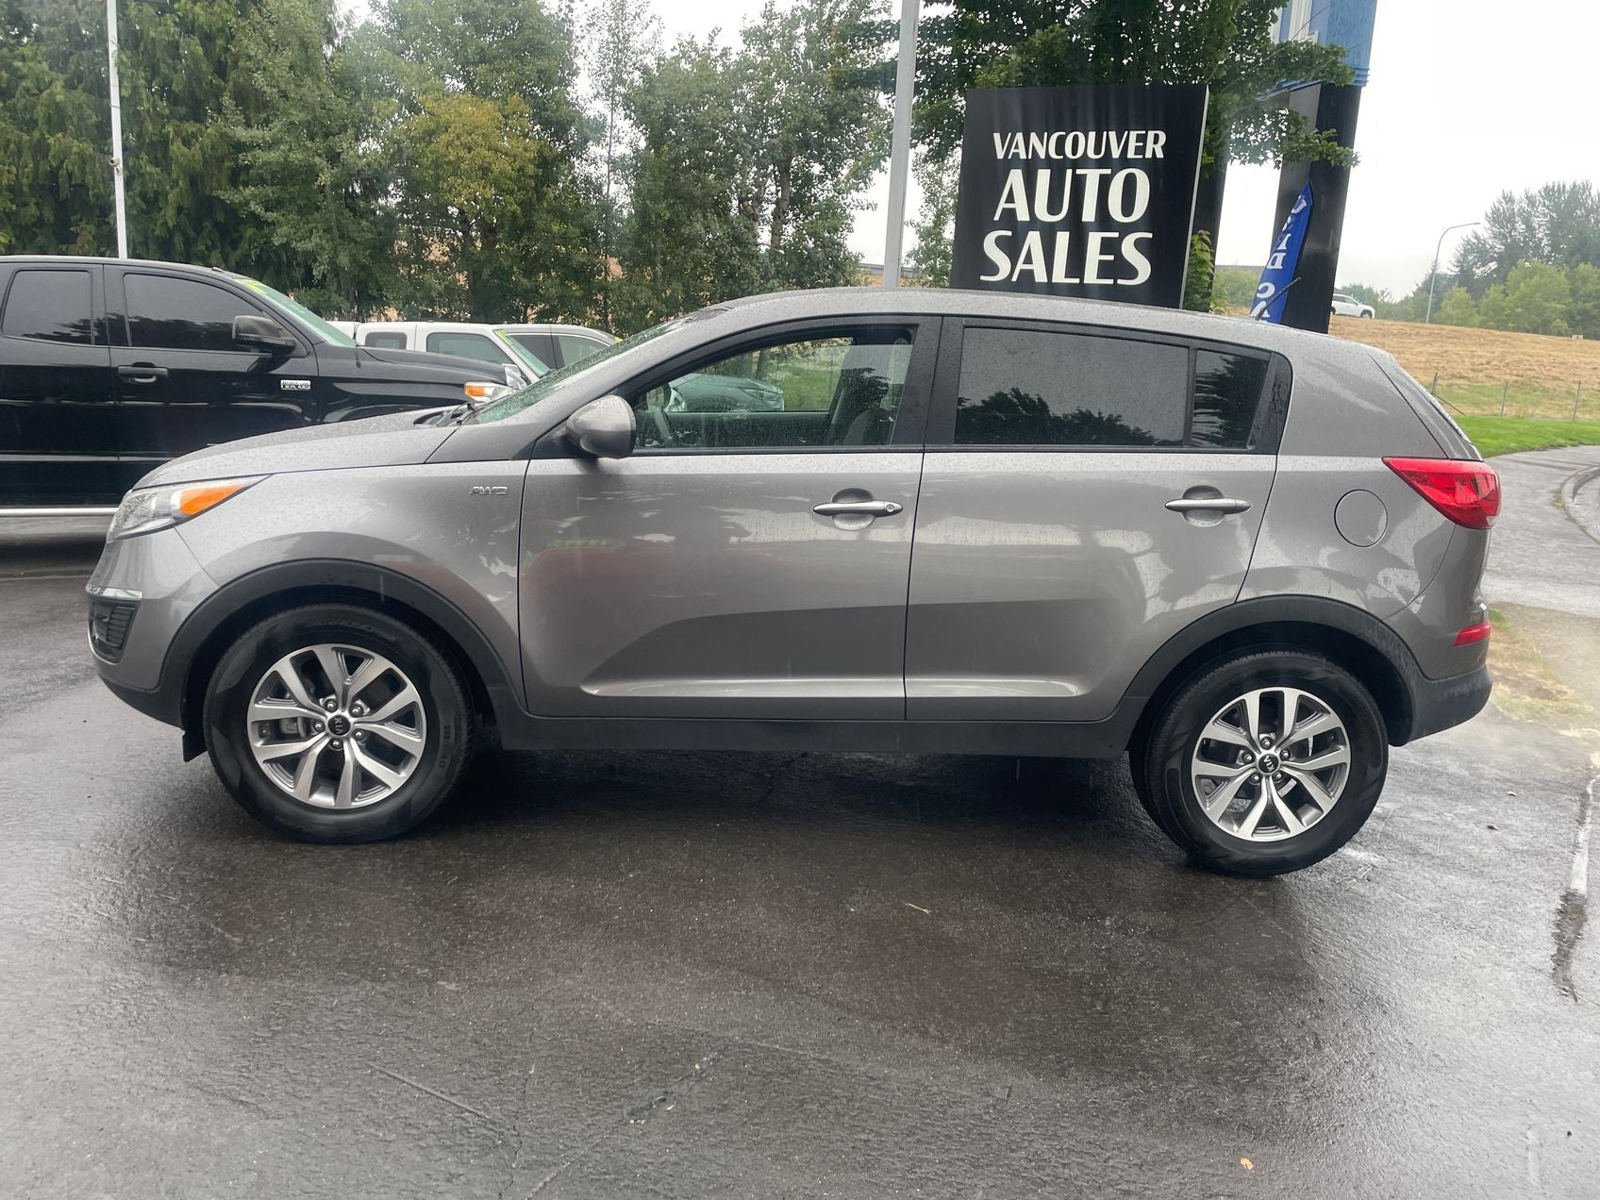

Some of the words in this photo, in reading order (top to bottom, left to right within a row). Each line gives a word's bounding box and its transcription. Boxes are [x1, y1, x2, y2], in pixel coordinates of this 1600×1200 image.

[993, 130, 1166, 159] VANCOUVER
[993, 168, 1150, 222] AUTO
[980, 230, 1153, 285] SALES
[469, 486, 508, 495] AWD
[334, 718, 343, 734] KIA
[1263, 755, 1275, 771] KIA
